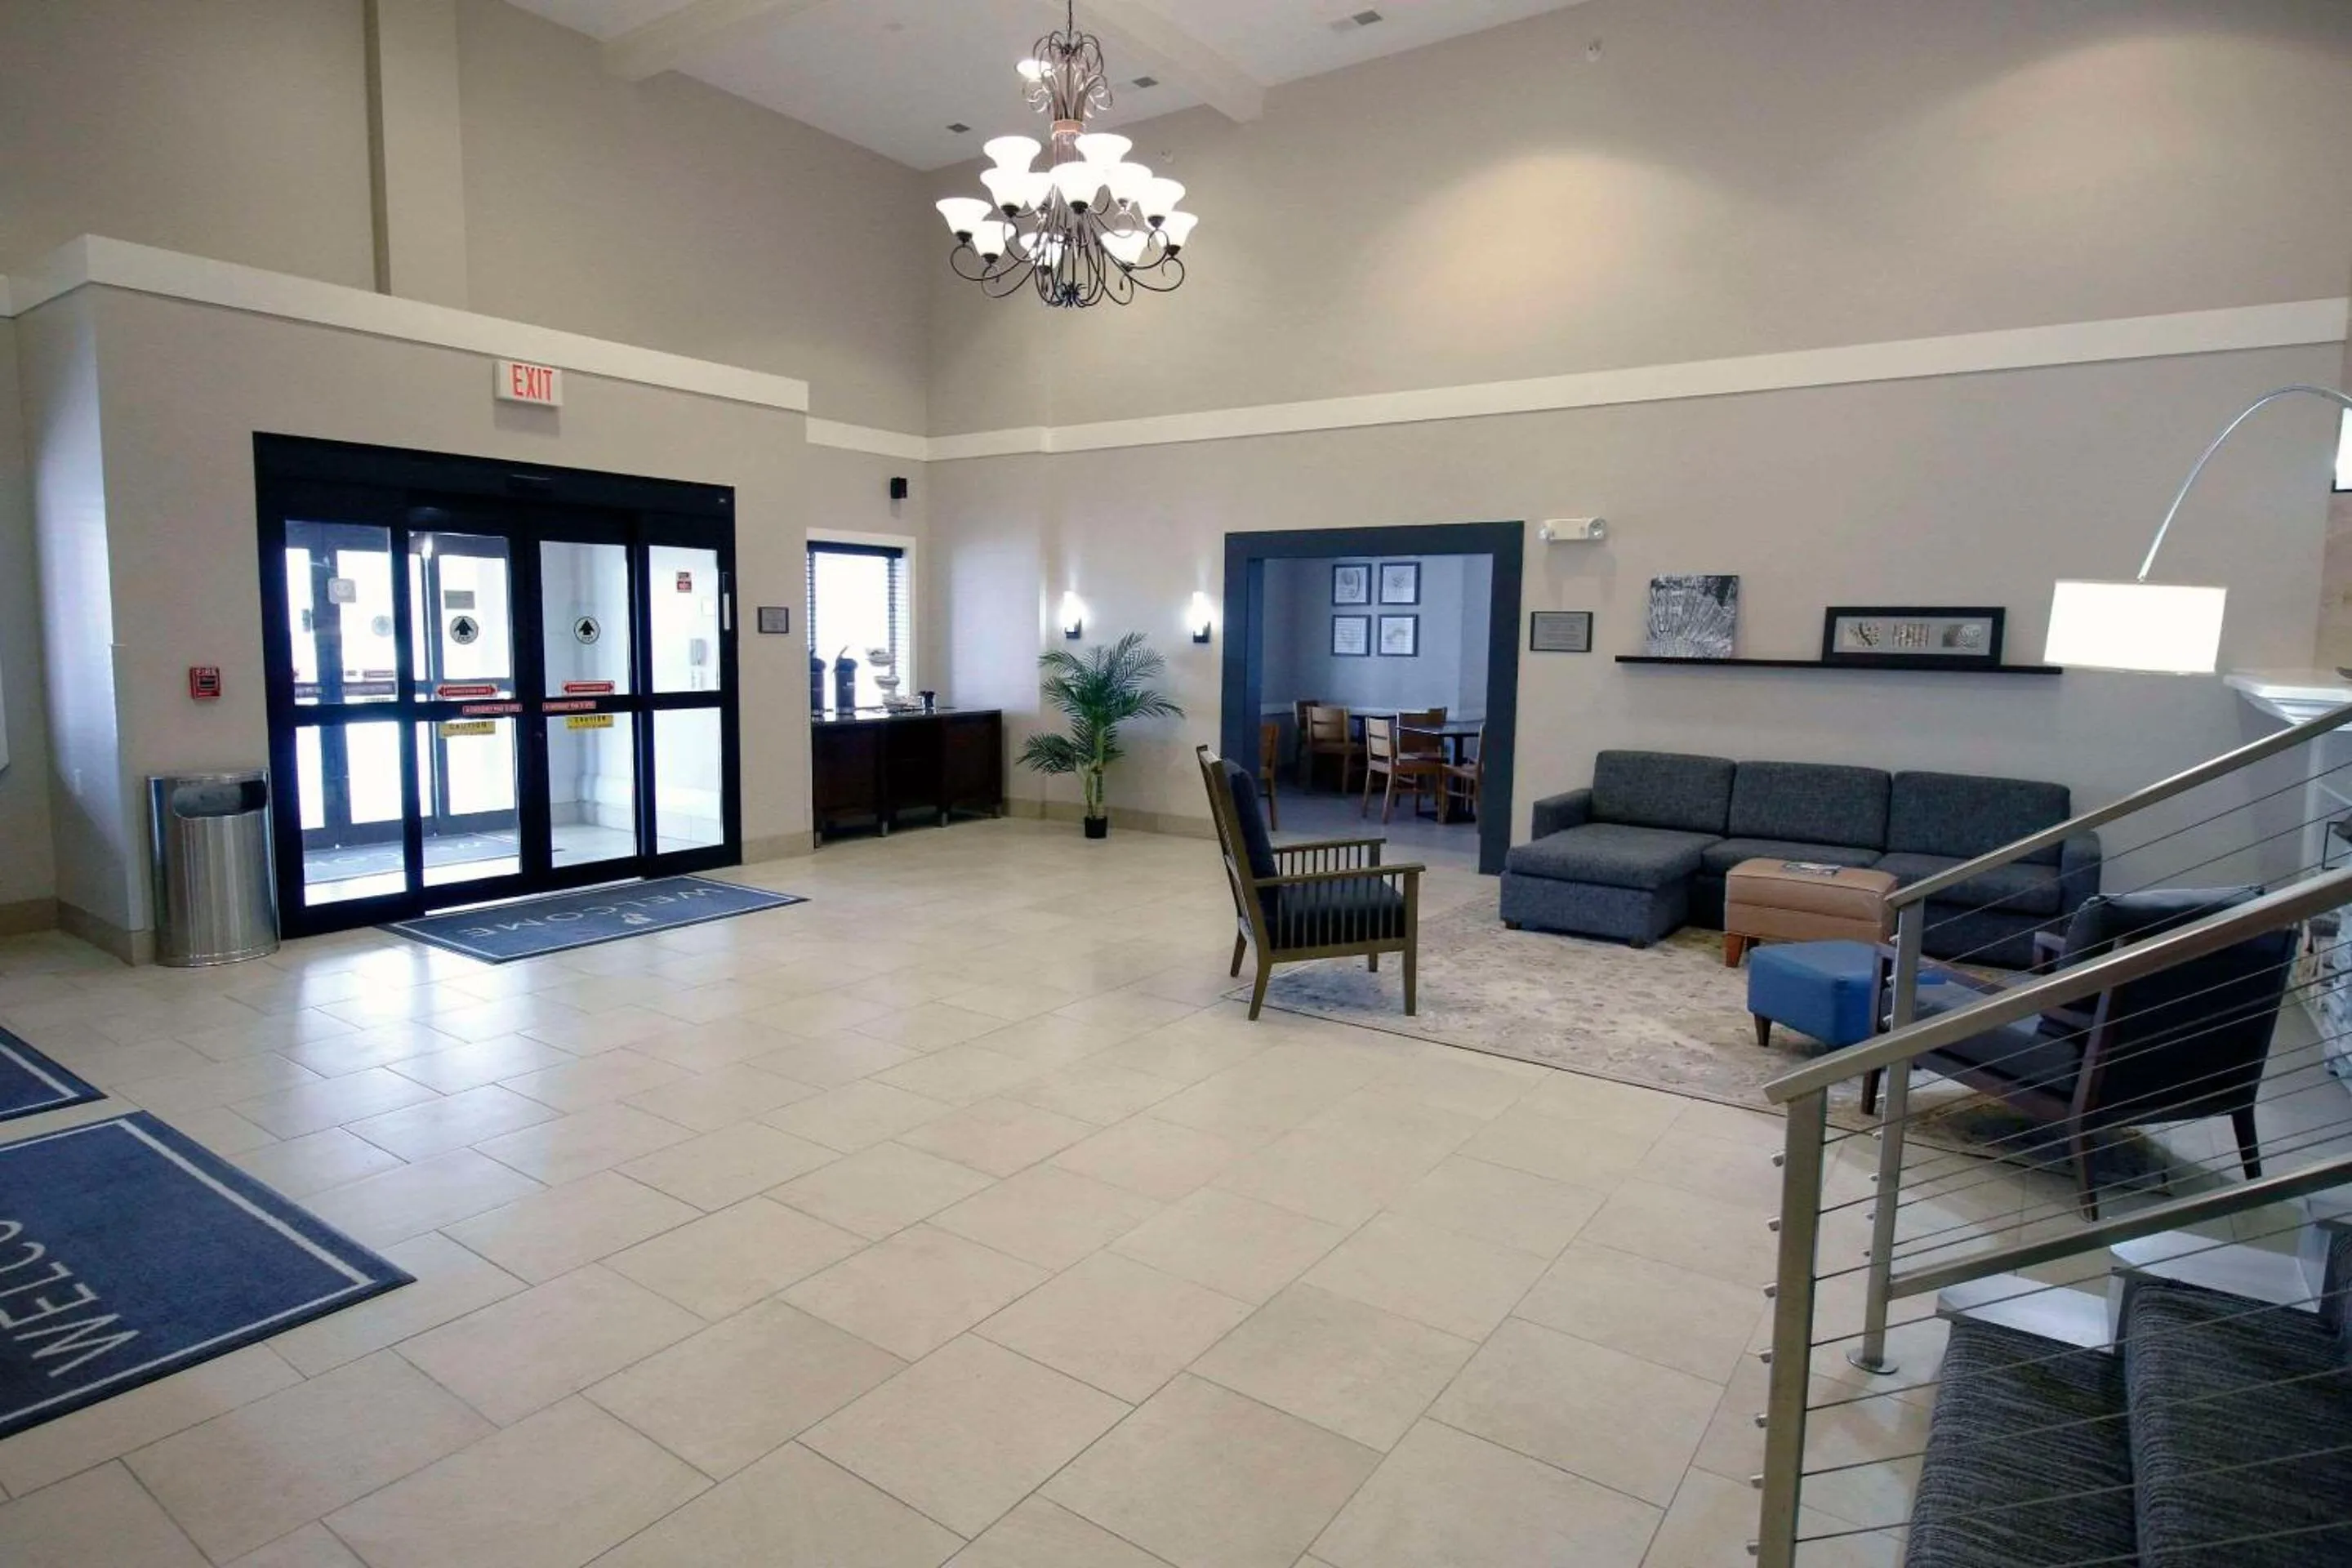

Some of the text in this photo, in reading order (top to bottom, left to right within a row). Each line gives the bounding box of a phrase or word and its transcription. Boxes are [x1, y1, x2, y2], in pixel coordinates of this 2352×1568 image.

[511, 363, 553, 403] EXIT
[459, 887, 724, 938] WELCOME
[0, 1220, 140, 1378] WELC
